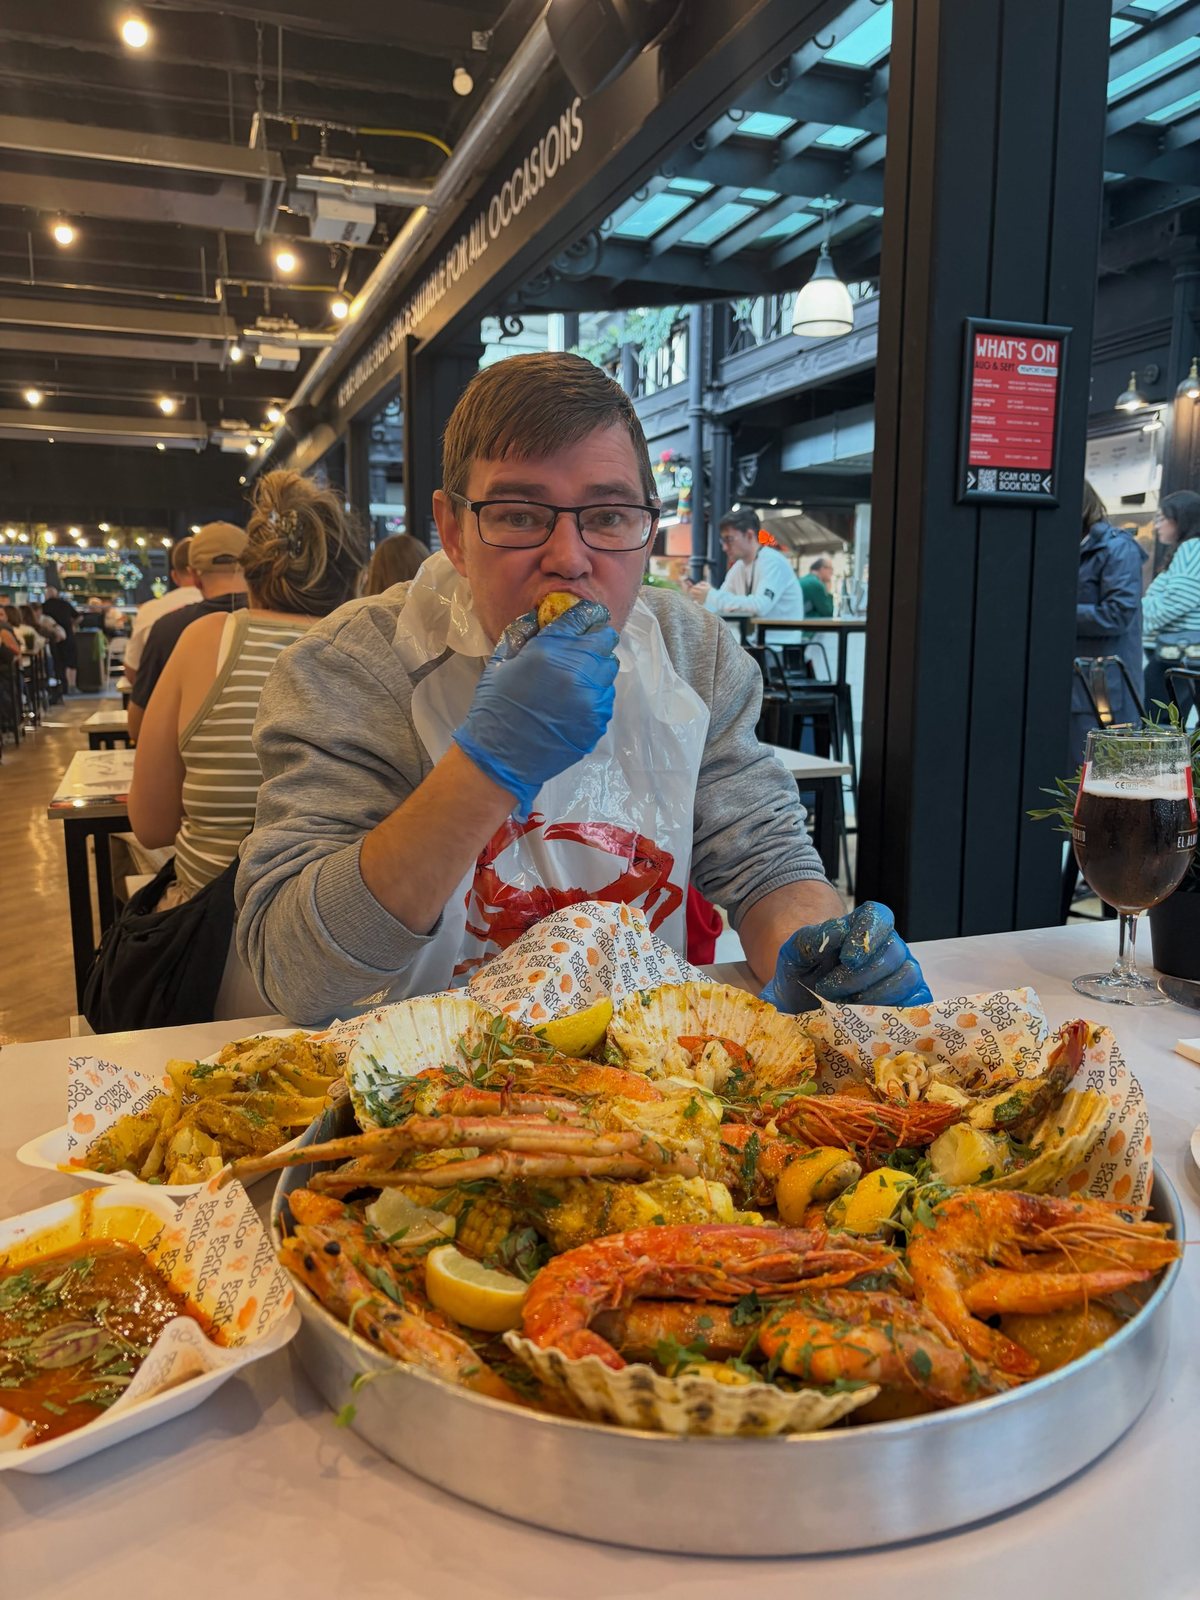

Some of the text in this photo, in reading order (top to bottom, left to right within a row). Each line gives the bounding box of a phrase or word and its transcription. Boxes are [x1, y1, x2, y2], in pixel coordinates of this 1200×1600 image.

[446, 235, 468, 289] FOR
[469, 211, 488, 266] ALL
[488, 97, 583, 239] OCCASIONS
[976, 337, 1056, 363] WHAT'S ON
[975, 360, 991, 370] AUG
[1000, 362, 1016, 372] SEPT
[999, 471, 1018, 481] SCAN
[1031, 473, 1042, 482] TO
[999, 481, 1020, 491] BOOK
[547, 931, 585, 947] SCALLOP
[525, 961, 561, 973] SCALLOP
[569, 956, 592, 993] SCALLOP
[836, 1002, 876, 1038] SCALLOP
[882, 1012, 921, 1040] SCALLOP
[934, 1022, 967, 1050] SCALLOP
[980, 1028, 1005, 1067] SCALLOP
[94, 1080, 125, 1111] SCALLOP
[131, 1085, 162, 1116] SCALLOP
[184, 1202, 208, 1264] SCALLOP
[195, 1237, 219, 1303] SCALLOP
